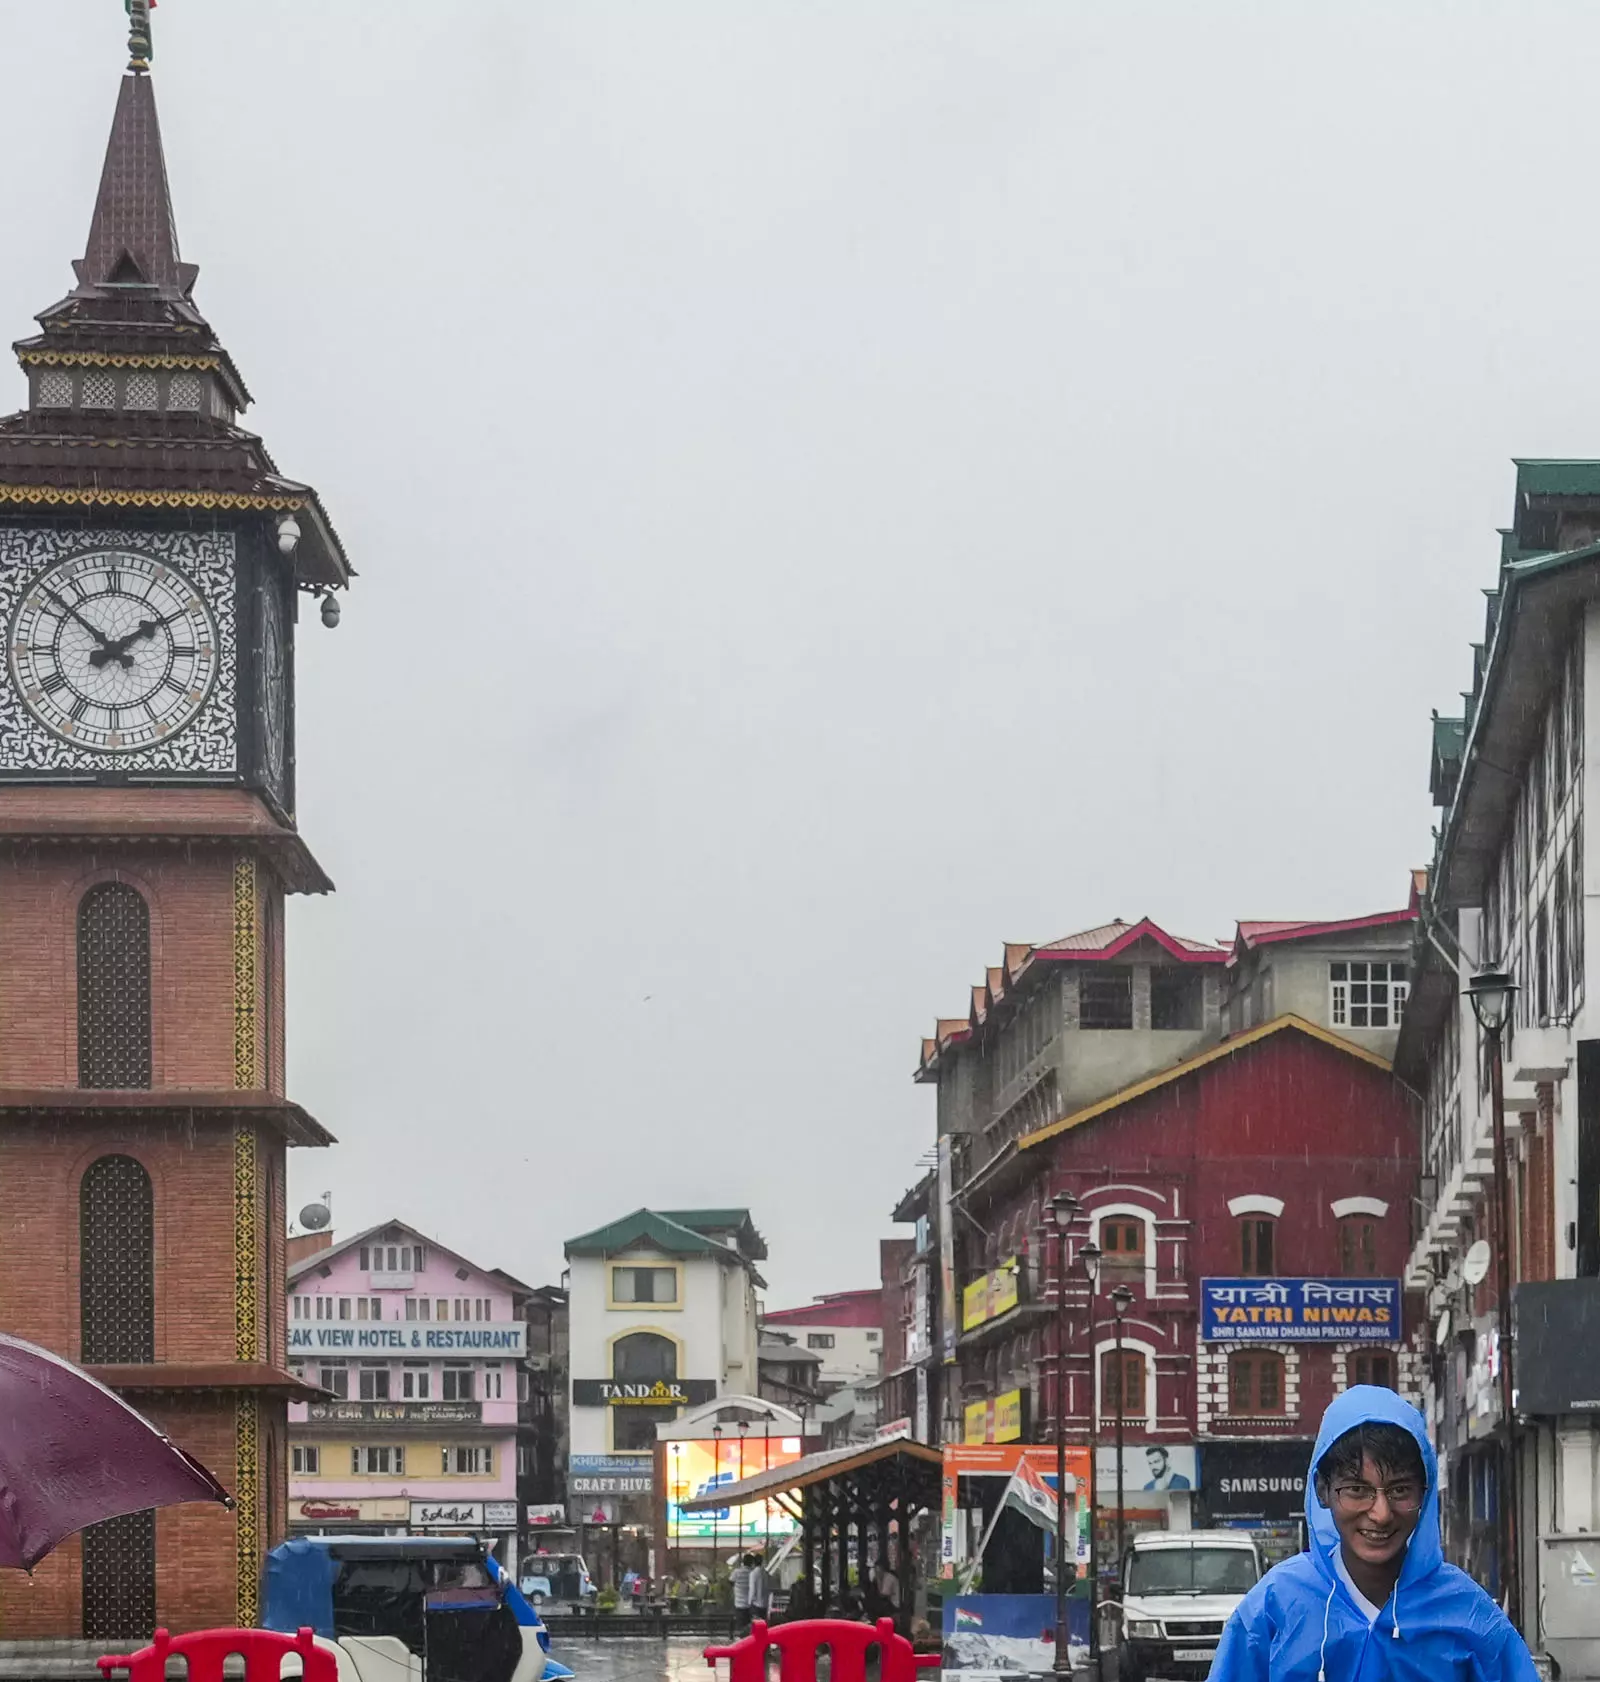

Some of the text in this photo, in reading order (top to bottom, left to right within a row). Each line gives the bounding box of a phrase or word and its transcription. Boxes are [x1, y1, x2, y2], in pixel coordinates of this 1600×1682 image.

[1208, 1282, 1394, 1304] यात्री निवास
[1212, 1307, 1391, 1323] YATRI NIWAS
[287, 1329, 521, 1348] EAK VIEW HOTEL & RESTAURANT
[1212, 1326, 1391, 1338] SHRI SANATAN DHARAM PRATAP SABHA
[600, 1384, 681, 1397] TANDOOR
[372, 1406, 406, 1419] VIEW
[571, 1456, 636, 1467] KHURSHID
[574, 1478, 652, 1492] CRAFT HIVE
[1220, 1477, 1304, 1493] SAMSUNG
[943, 1536, 953, 1557] Ghar
